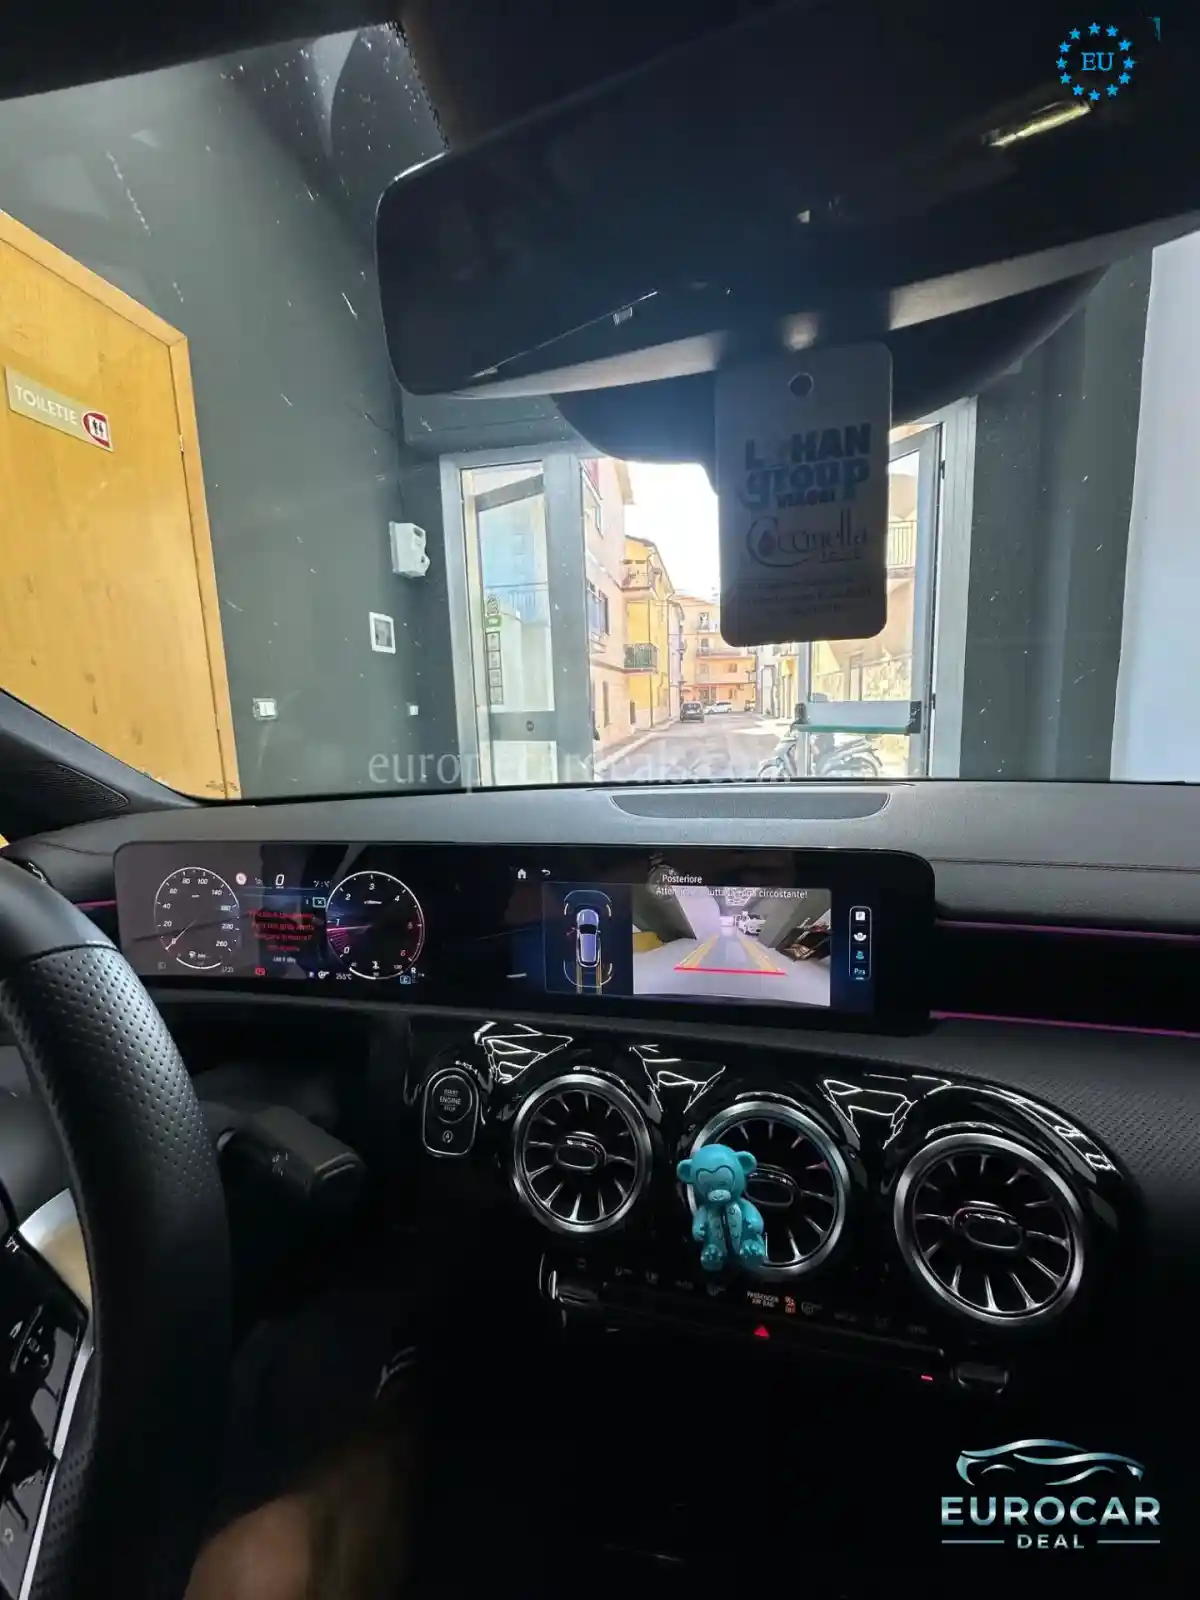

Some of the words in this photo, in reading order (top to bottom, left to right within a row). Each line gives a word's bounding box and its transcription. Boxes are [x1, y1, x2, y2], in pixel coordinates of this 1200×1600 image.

[14, 384, 78, 426] TOILETTE
[276, 874, 285, 886] 0
[662, 874, 703, 884] Posteriore
[759, 889, 808, 899] circostante!
[344, 946, 350, 954] 0
